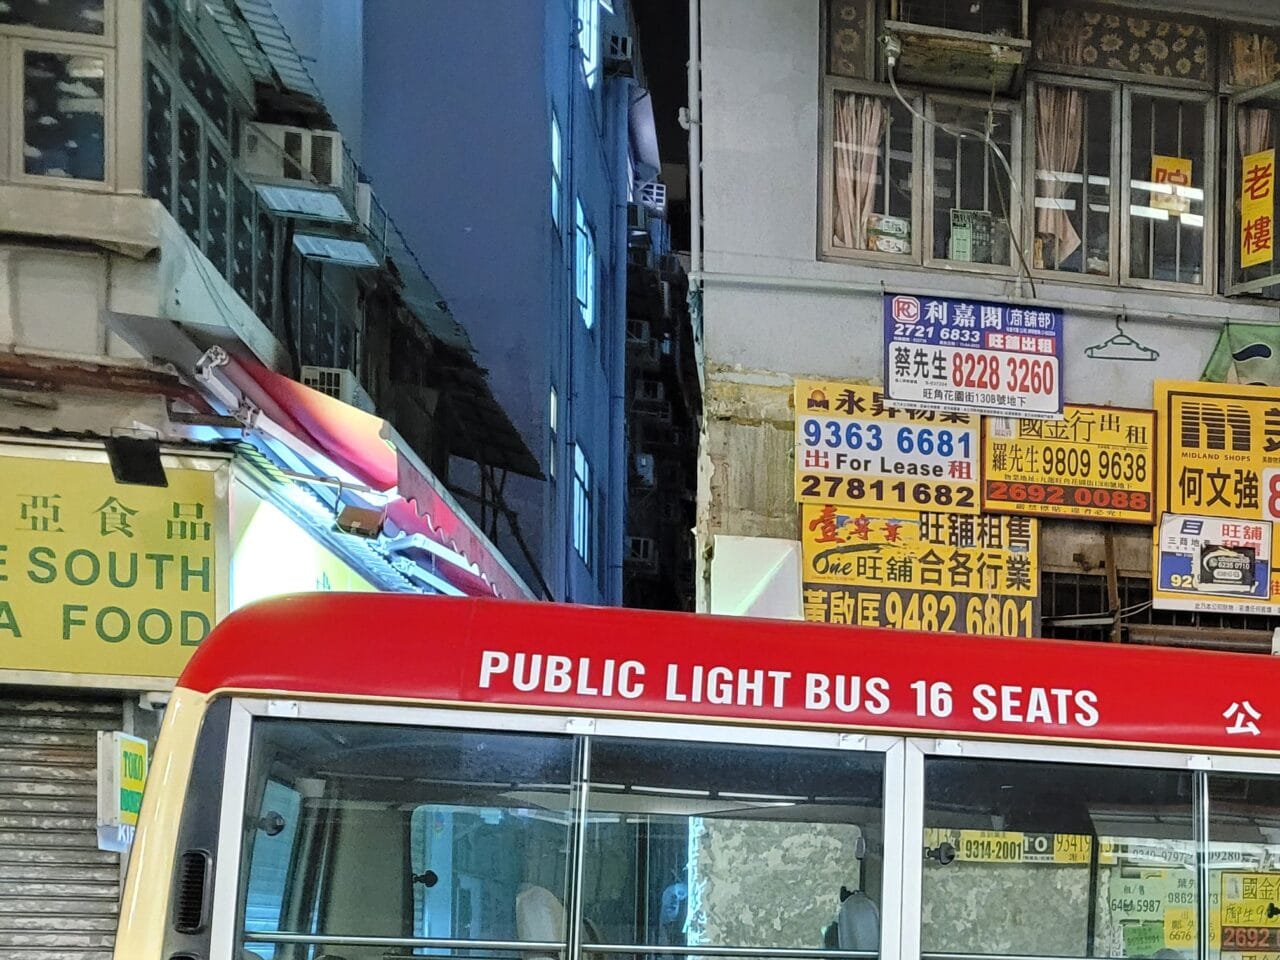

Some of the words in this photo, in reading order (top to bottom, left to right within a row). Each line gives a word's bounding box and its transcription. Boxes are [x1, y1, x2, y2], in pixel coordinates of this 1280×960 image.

[894, 323, 935, 339] 2721
[940, 328, 981, 343] 6833
[924, 301, 1003, 331] 利嘉閣
[894, 346, 948, 381] 蔡先生
[952, 351, 1000, 391] 8228
[1006, 357, 1055, 396] 3260
[804, 419, 883, 452] 9363
[897, 426, 971, 459] 6681
[1181, 451, 1220, 460] MIDLAND
[1224, 454, 1251, 462] SHOPS
[805, 449, 830, 469] 出
[836, 453, 872, 472] For
[880, 456, 944, 477] Lease
[948, 460, 972, 480] 租
[991, 442, 1039, 474] 羅先生
[1042, 446, 1091, 478] 9809
[1099, 450, 1147, 483] 9638
[801, 474, 975, 508] 27811682
[990, 481, 1065, 504] 2692
[1074, 487, 1148, 511] 0088
[1179, 465, 1260, 510] 何文強
[15, 494, 212, 541] 亞食品
[27, 546, 210, 593] SOUTH
[62, 603, 212, 648] FOOD
[885, 591, 957, 632] 9482
[966, 596, 1033, 638] 6801
[478, 649, 647, 699] PUBLIC
[665, 662, 792, 710] LIGHT
[804, 671, 891, 716] BUS
[910, 679, 954, 719] 16
[972, 682, 1100, 728] SEATS
[964, 839, 1022, 861] 9314-2001
[1223, 928, 1270, 948] 2692
